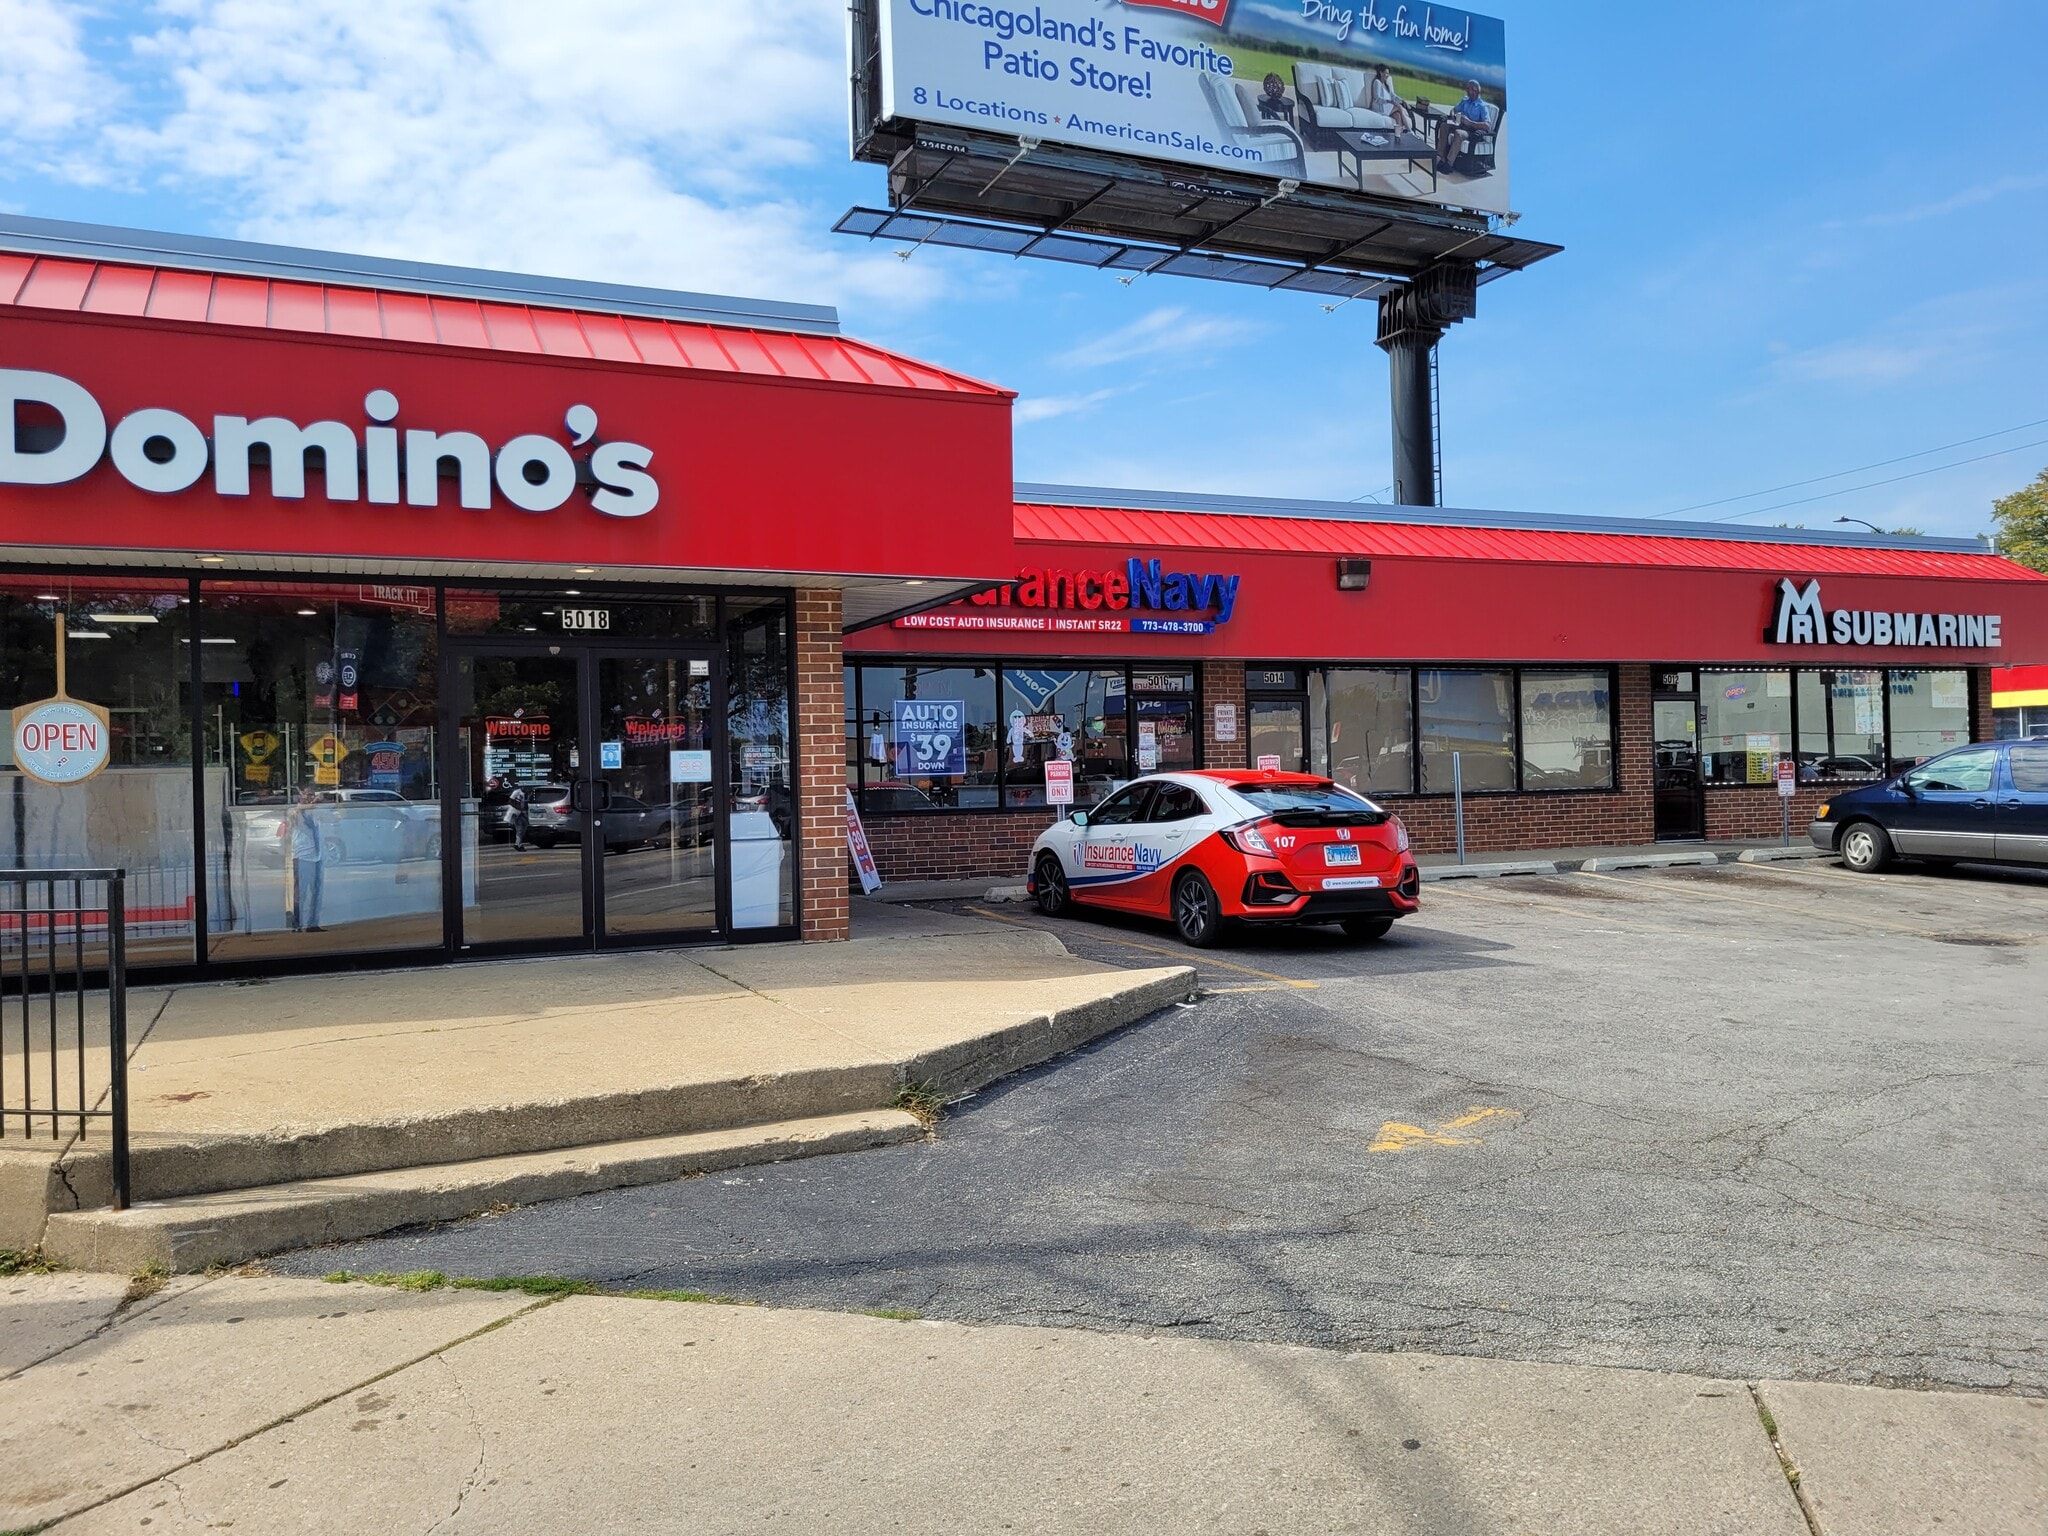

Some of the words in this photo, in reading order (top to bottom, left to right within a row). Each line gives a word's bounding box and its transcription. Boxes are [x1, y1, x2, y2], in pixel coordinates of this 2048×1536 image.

[1359, 6, 1388, 32] the
[1391, 9, 1419, 37] fun
[1423, 16, 1469, 48] home!
[910, 0, 1117, 51] Chicagoland's
[1124, 26, 1234, 76] Favorite
[984, 40, 1059, 81] Patio
[1069, 58, 1152, 99] Store!
[913, 86, 928, 105] 8
[936, 91, 1048, 125] Locations
[1066, 114, 1264, 163] AmericanSale.com
[0, 368, 660, 518] Domino's
[372, 585, 404, 602] TRACK
[406, 589, 418, 604] IT!
[564, 610, 608, 629] 5018
[904, 616, 927, 627] LOW
[929, 617, 956, 628] COST
[957, 617, 984, 628] AUTO
[986, 618, 1045, 630] INSURANCE
[1055, 620, 1096, 631] INSTANT
[1098, 621, 1122, 632] SR22
[1142, 621, 1204, 633] 773-478-3700
[1832, 609, 2002, 647] SUBMARINE
[1148, 675, 1169, 686] 5016
[1264, 672, 1284, 683] 5014
[1663, 674, 1679, 684] 5012
[1725, 686, 1747, 698] OPEN
[901, 704, 958, 721] AUTO
[485, 721, 551, 736] Welcome
[625, 720, 686, 735] Welcome
[902, 721, 958, 729] INSURANCE
[22, 722, 97, 752] OPEN
[918, 762, 945, 770] DOWN
[1051, 787, 1068, 797] ONLY
[1273, 836, 1296, 848] 107
[1084, 841, 1162, 869] InsuranceNavy
